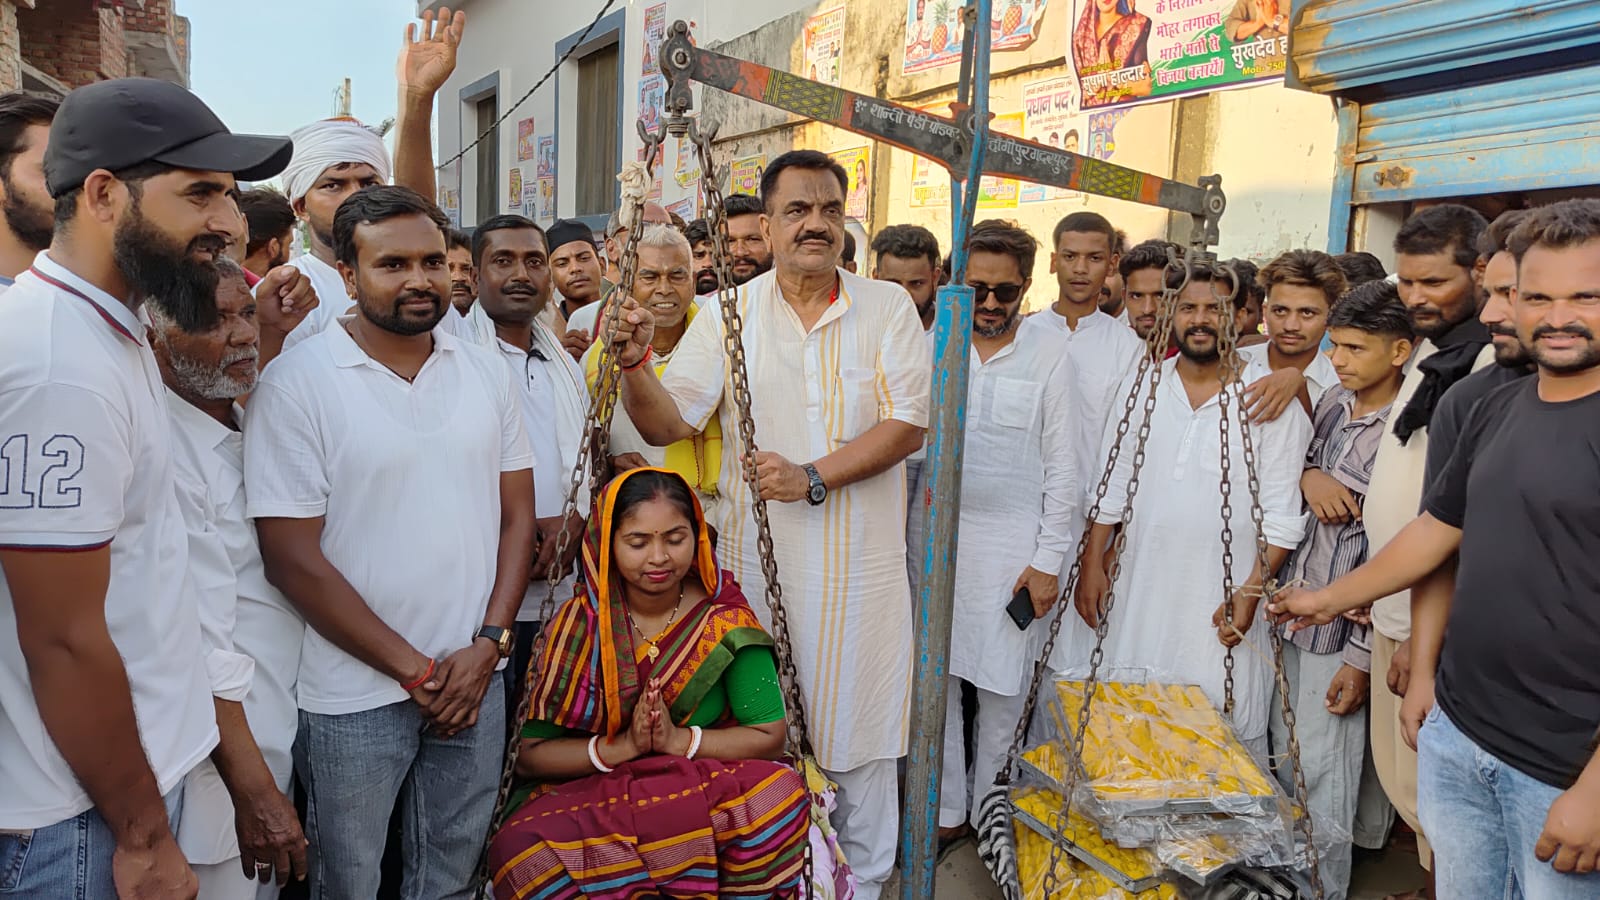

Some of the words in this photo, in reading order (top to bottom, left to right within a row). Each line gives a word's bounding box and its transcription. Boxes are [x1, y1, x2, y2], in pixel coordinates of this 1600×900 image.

[1156, 22, 1180, 38] मोहर
[1183, 12, 1221, 32] लगाकर
[1160, 41, 1182, 60] भारी
[1210, 33, 1220, 52] से
[1231, 35, 1275, 69] सुखदेव
[1080, 73, 1108, 96] सुषमा
[1157, 68, 1186, 85] विजय
[1025, 95, 1052, 119] प्रधान
[1054, 90, 1071, 111] पद
[0, 434, 85, 509] 12
